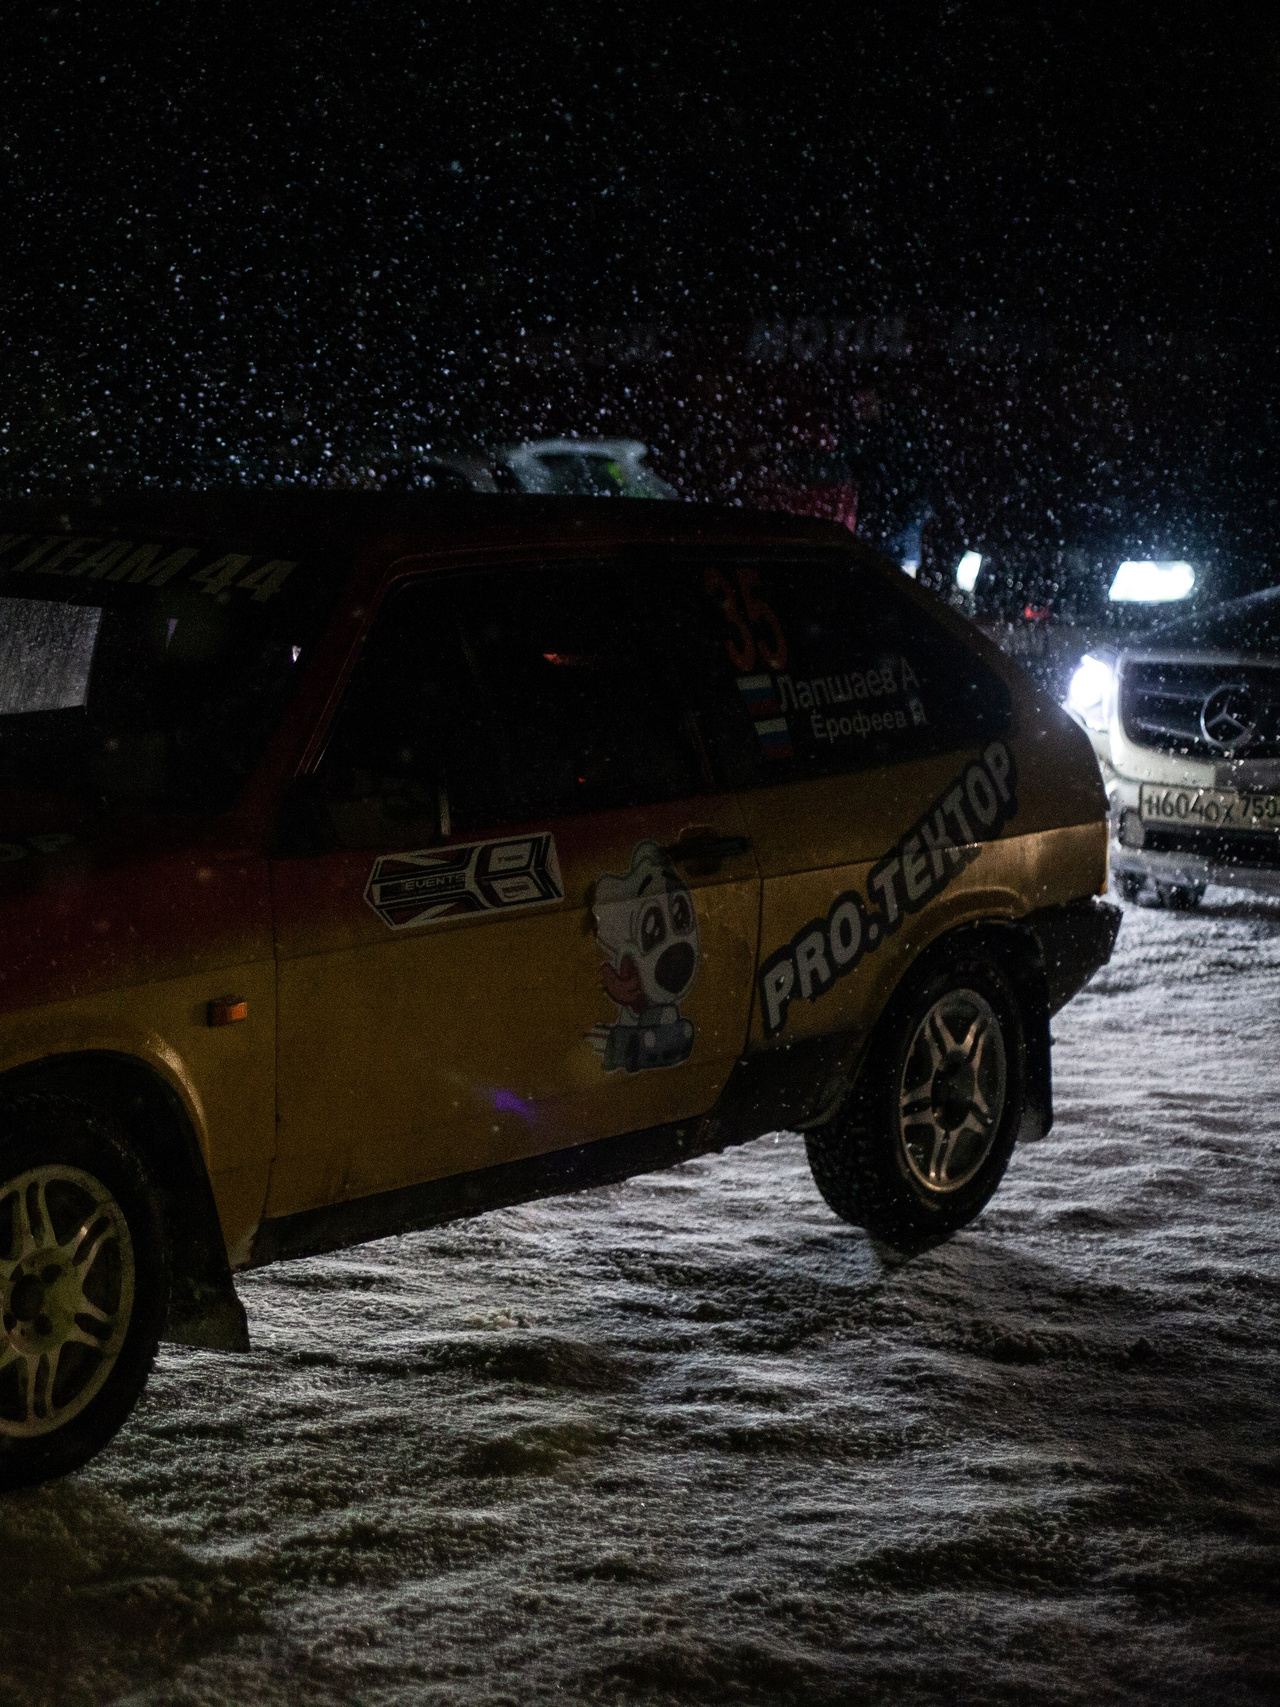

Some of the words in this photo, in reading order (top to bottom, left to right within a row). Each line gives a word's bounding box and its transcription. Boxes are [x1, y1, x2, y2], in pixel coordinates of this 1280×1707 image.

[11, 534, 200, 588] TEAM
[189, 553, 299, 602] 44
[702, 566, 789, 672] 35
[405, 872, 466, 891] EVENTS
